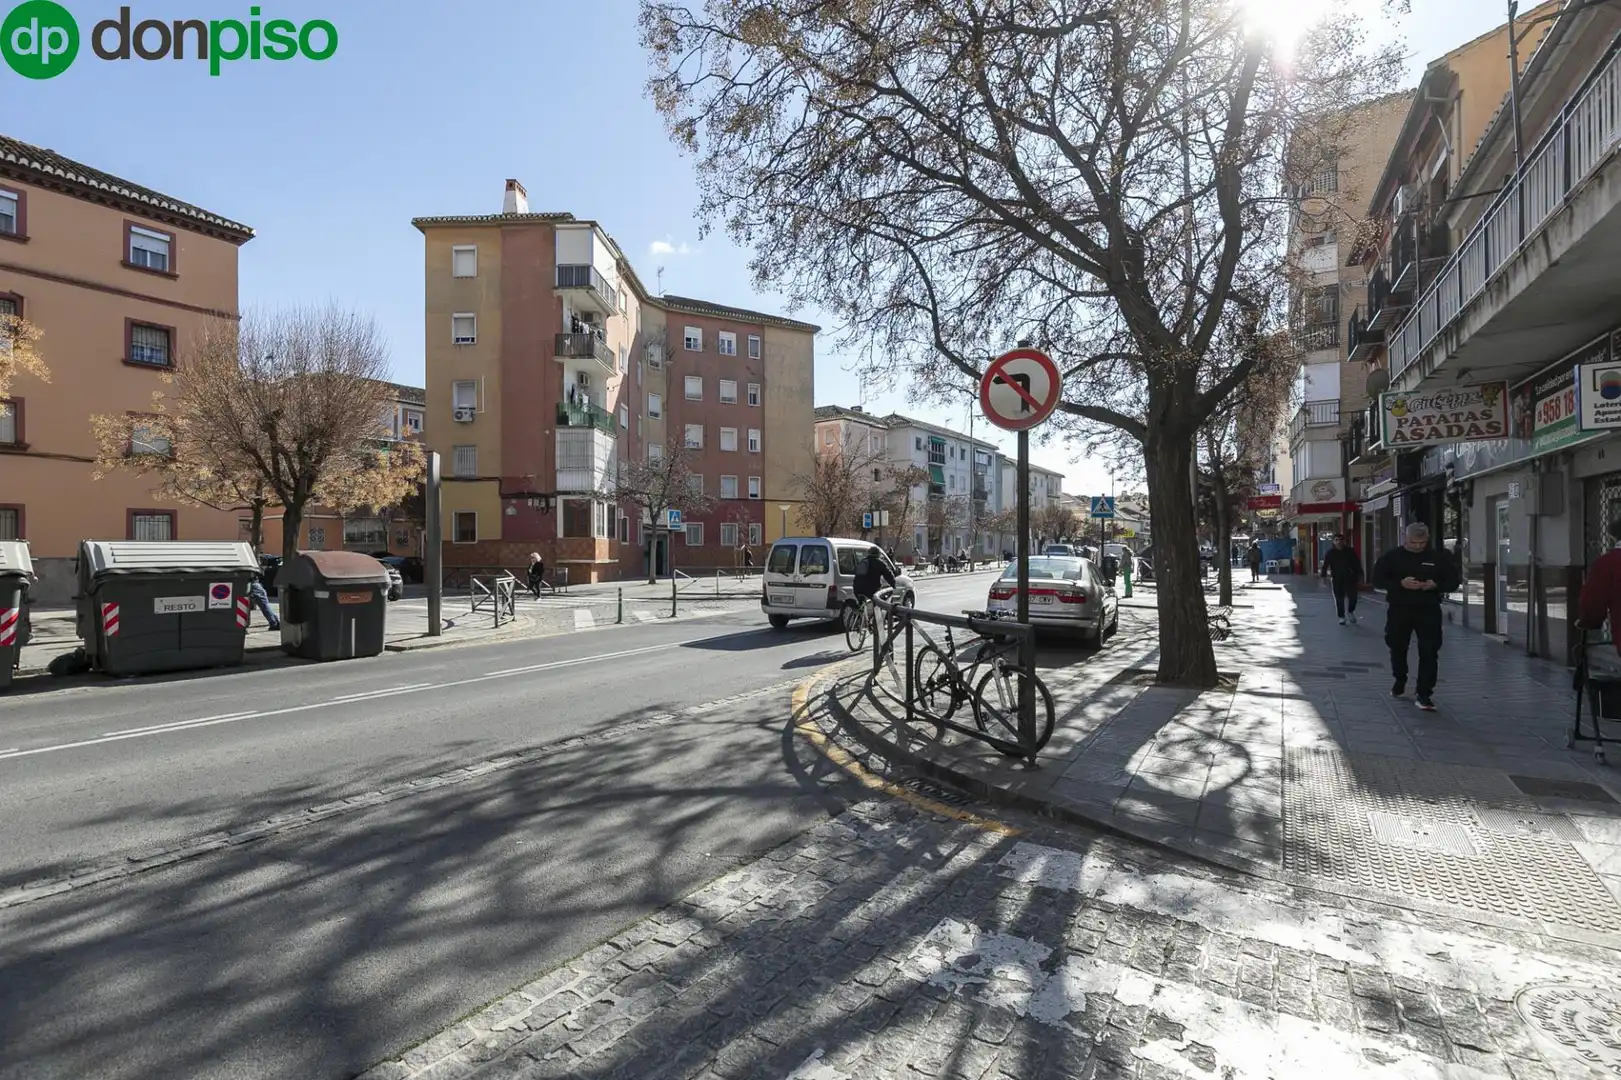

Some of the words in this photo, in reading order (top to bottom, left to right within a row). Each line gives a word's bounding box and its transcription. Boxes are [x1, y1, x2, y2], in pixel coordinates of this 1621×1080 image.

[1396, 409, 1493, 429] PATATAS
[1543, 396, 1561, 425] 958
[1391, 420, 1502, 443] ASADAS
[163, 602, 196, 612] RESTO
